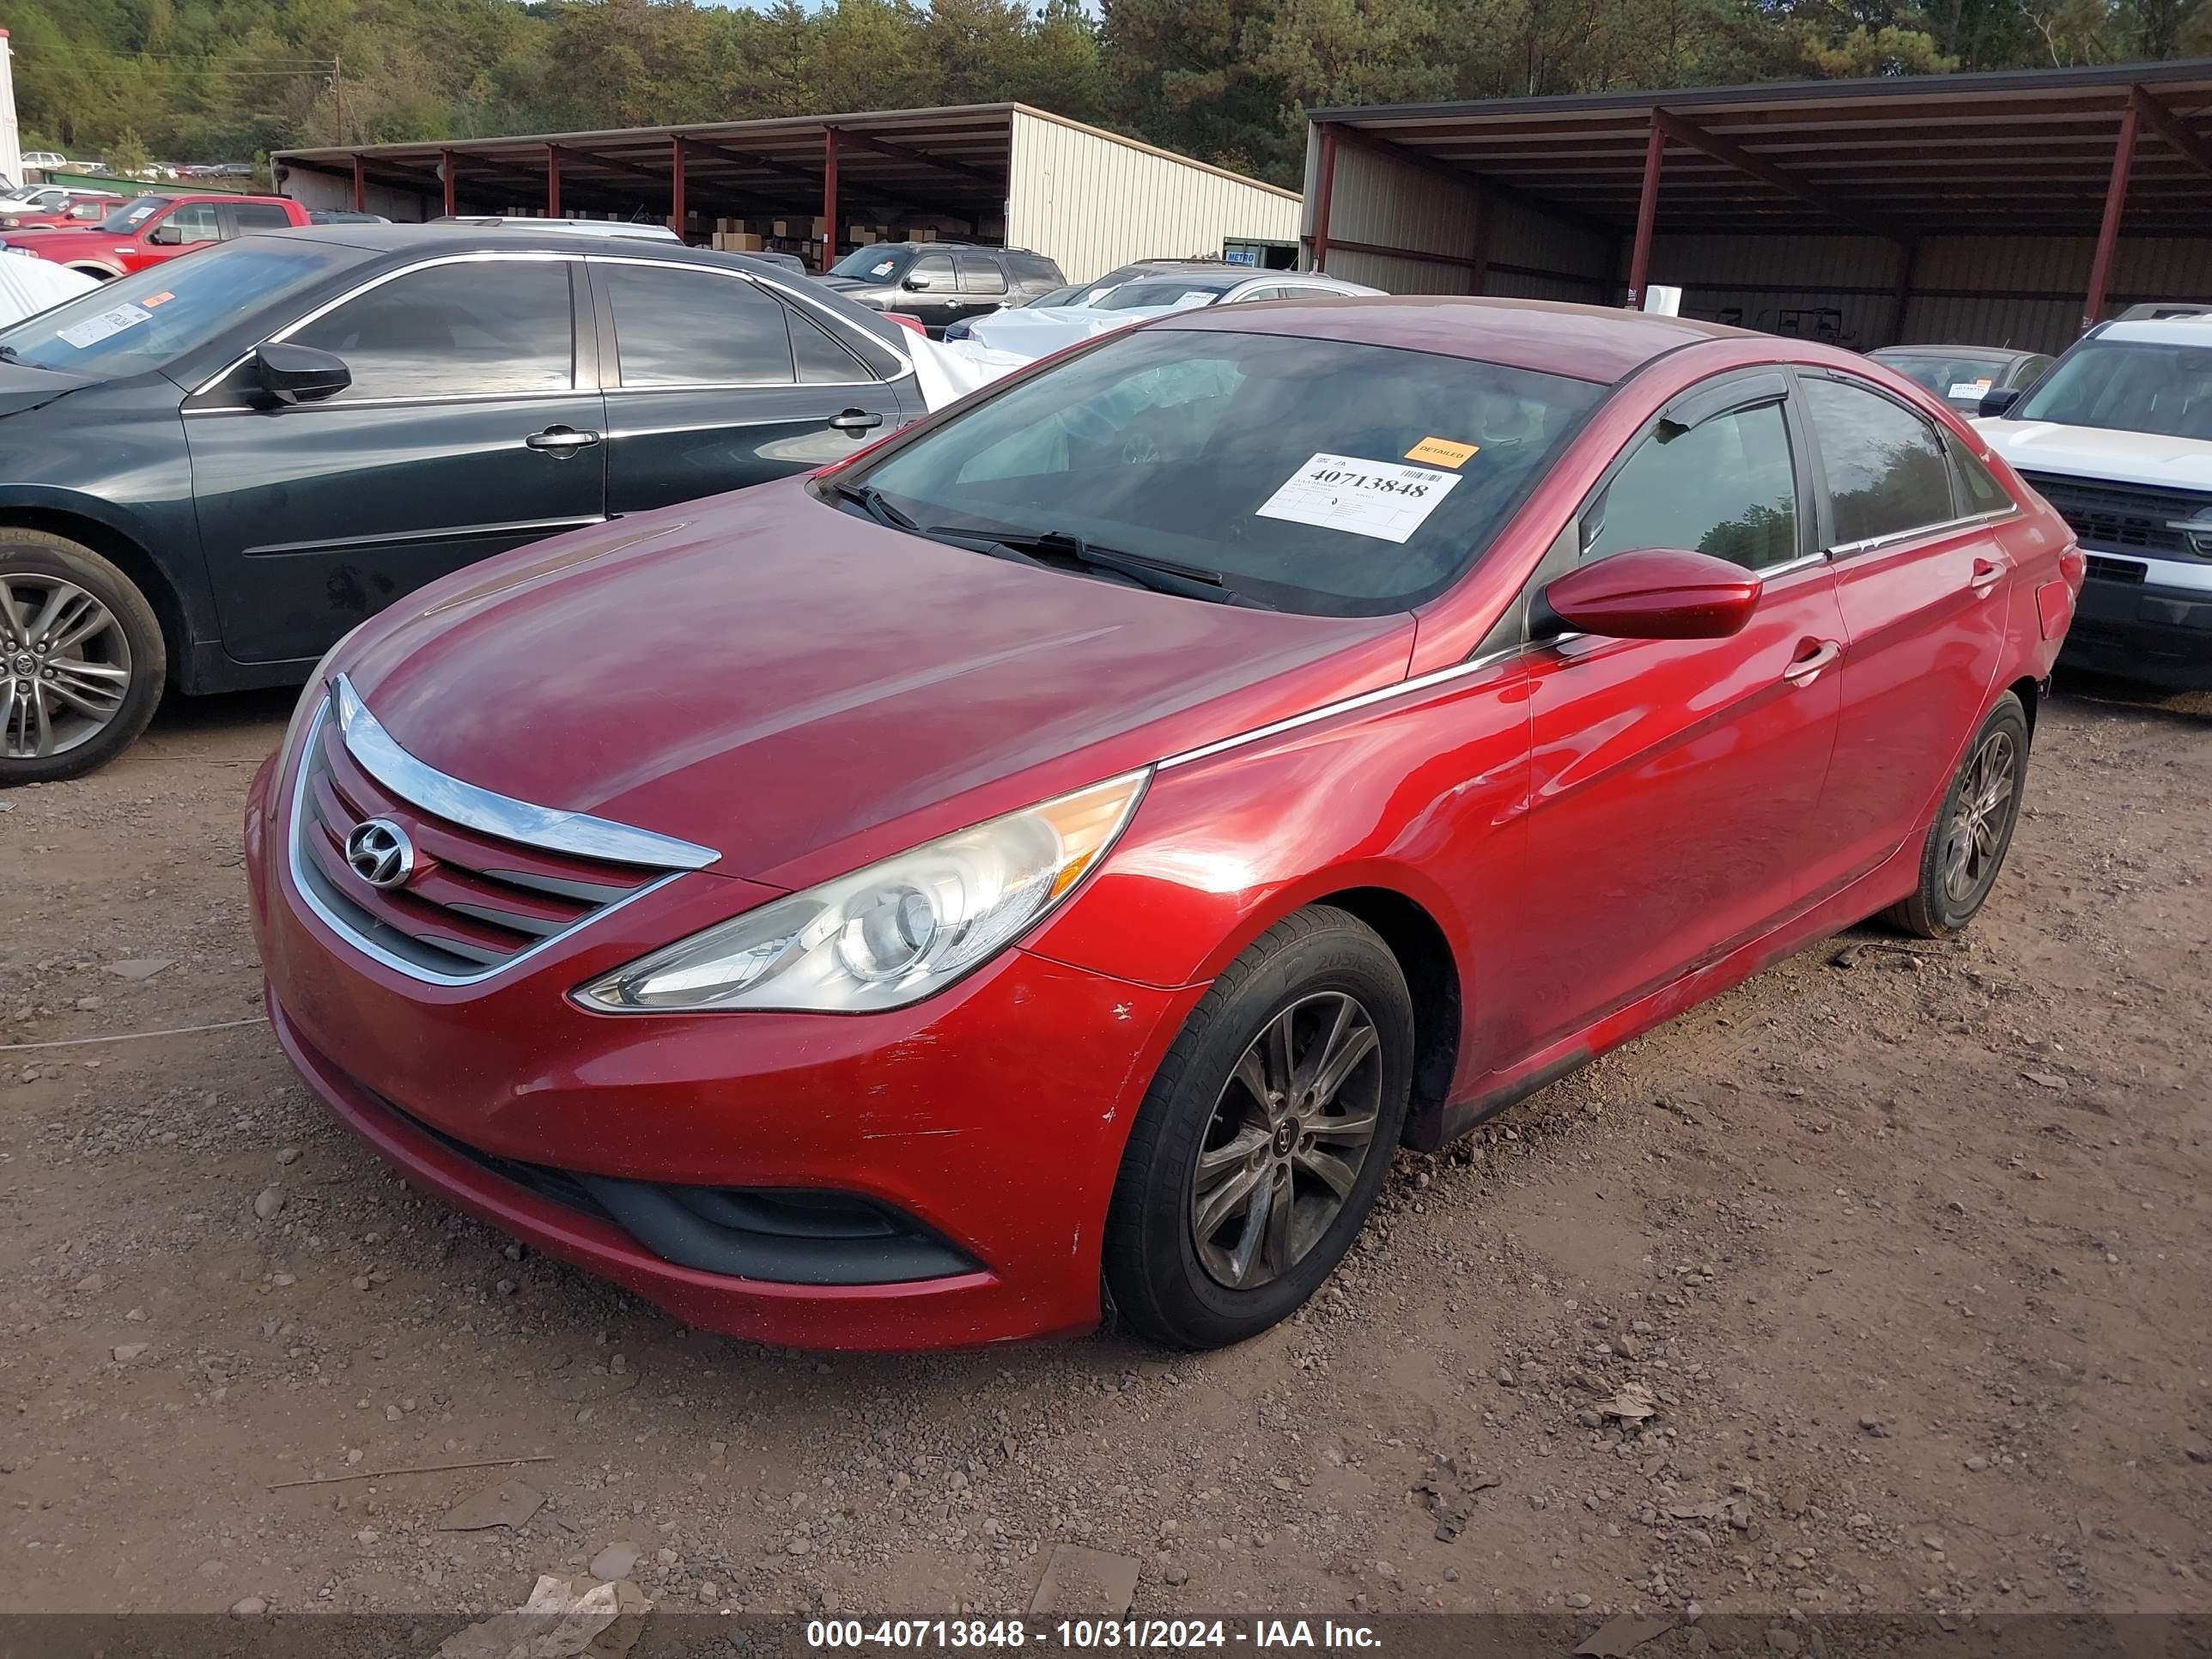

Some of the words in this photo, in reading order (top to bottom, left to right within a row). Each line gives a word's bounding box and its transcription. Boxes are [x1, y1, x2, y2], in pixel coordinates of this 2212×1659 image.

[1229, 253, 1254, 262] METRO
[1419, 446, 1463, 459] DETAILED
[1310, 469, 1428, 497] 40713848
